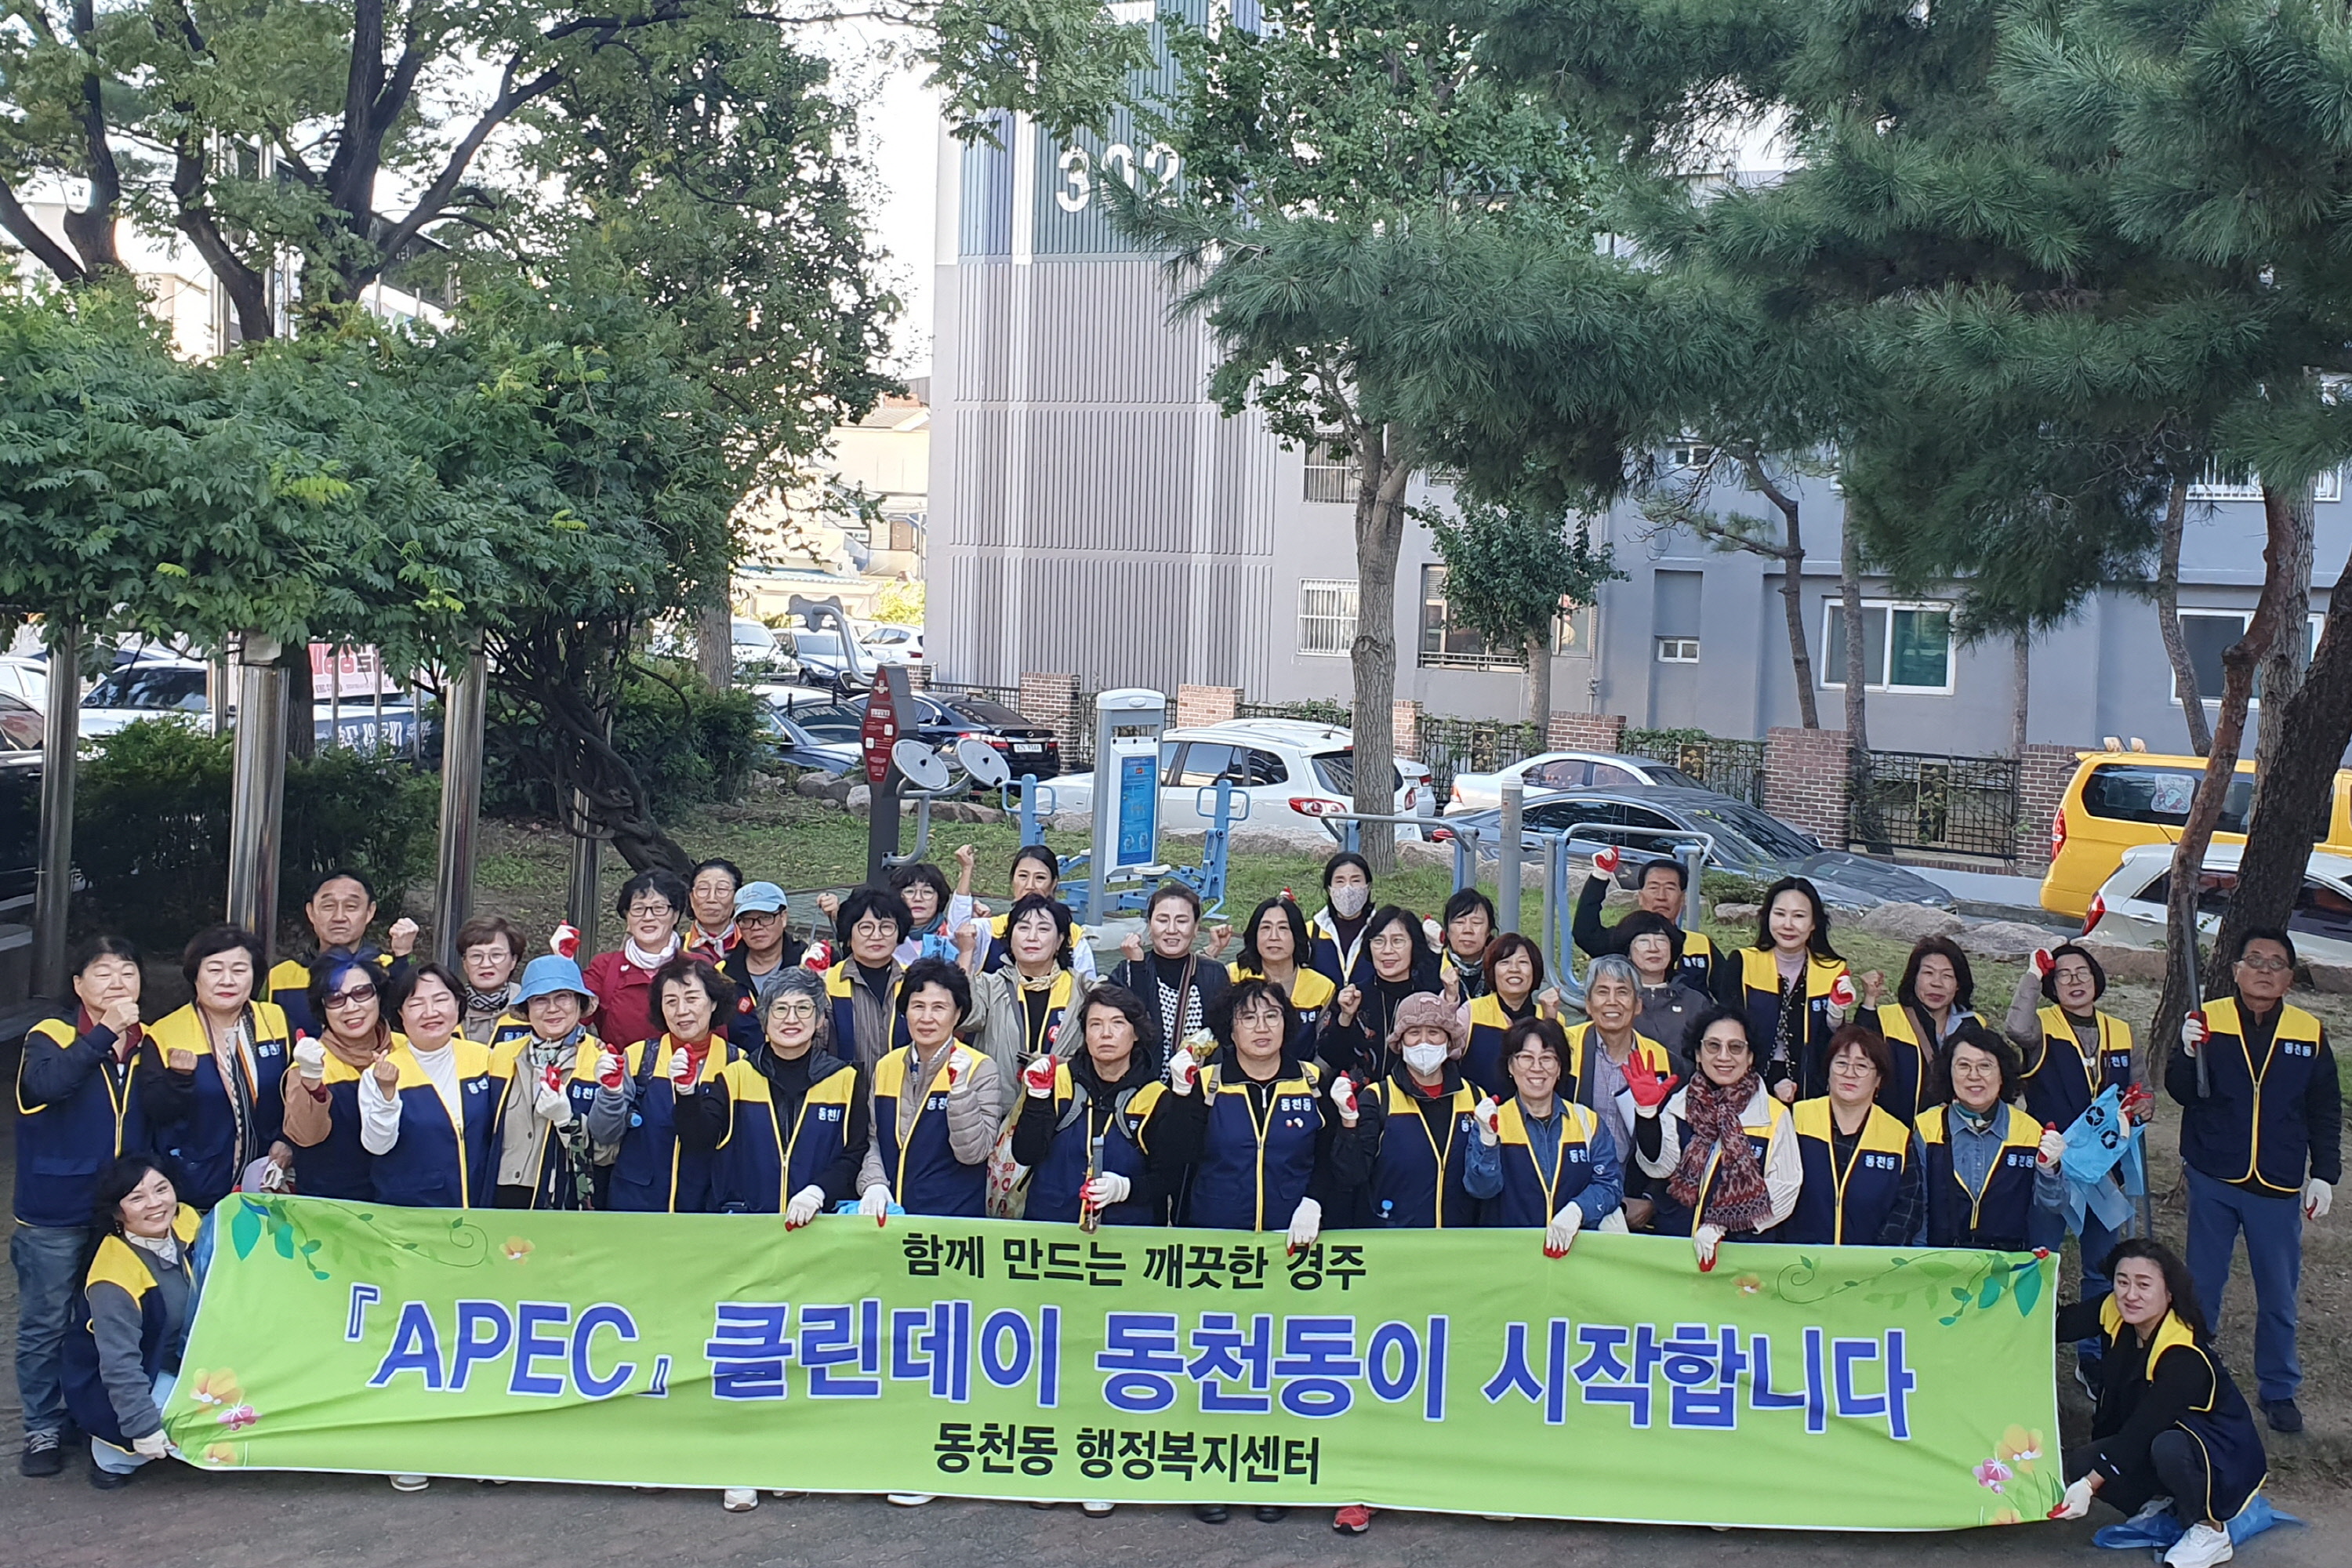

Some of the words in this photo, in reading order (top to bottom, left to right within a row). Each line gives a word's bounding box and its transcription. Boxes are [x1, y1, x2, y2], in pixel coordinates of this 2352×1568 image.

[1055, 143, 1180, 212] 302
[818, 1107, 841, 1123] 동천
[1281, 1098, 1312, 1112] 동천동
[1865, 1154, 1895, 1171] 동천동
[902, 1232, 985, 1279] 함께
[1003, 1237, 1127, 1287] 만드는
[1142, 1243, 1269, 1290] 깨끗한
[1286, 1243, 1367, 1291] 경주
[703, 1298, 1062, 1408] 클린데이
[1094, 1310, 1449, 1422] 동천동이
[1480, 1317, 1917, 1440] 시작합니다
[934, 1422, 1058, 1475] 동천동
[1076, 1427, 1320, 1485] 행정복지센터
